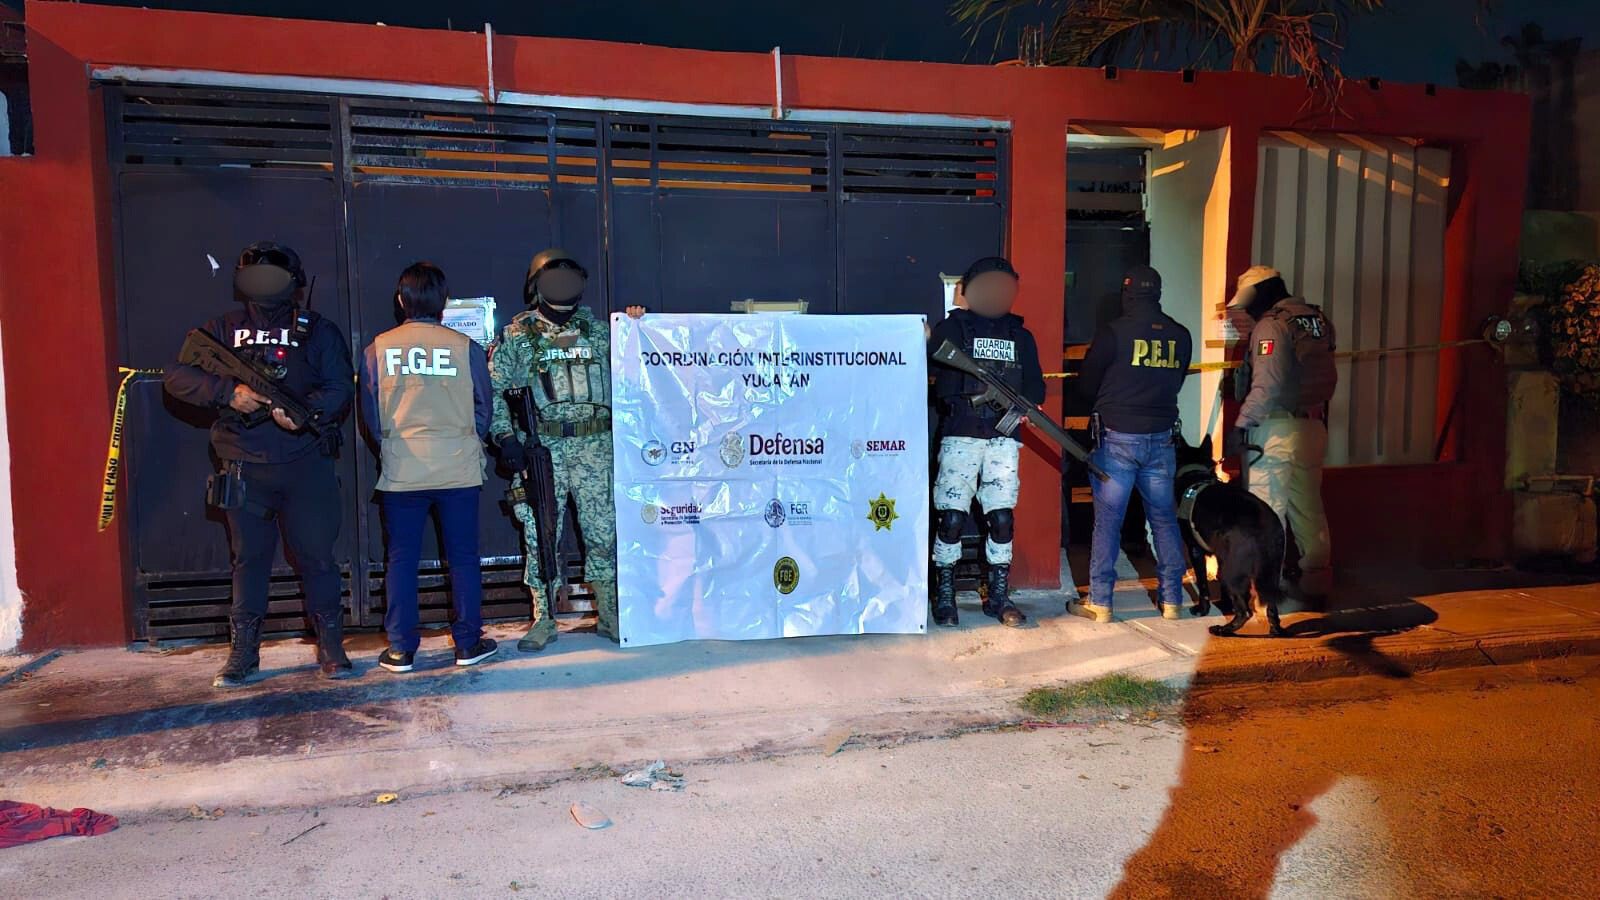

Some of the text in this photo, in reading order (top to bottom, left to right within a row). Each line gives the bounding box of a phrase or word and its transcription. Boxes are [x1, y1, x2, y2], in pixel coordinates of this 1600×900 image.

[234, 328, 299, 348] P.E.I.
[976, 339, 1012, 350] GUARDIA
[640, 349, 907, 367] COORDINACIÓN INTERINSTITUCIONAL
[974, 349, 1014, 360] NACIONAL
[1131, 339, 1180, 368] P.E.I.
[671, 441, 695, 454] GN
[749, 432, 824, 456] Defensa
[866, 440, 906, 451] SEMAR
[790, 503, 808, 515] FGR
